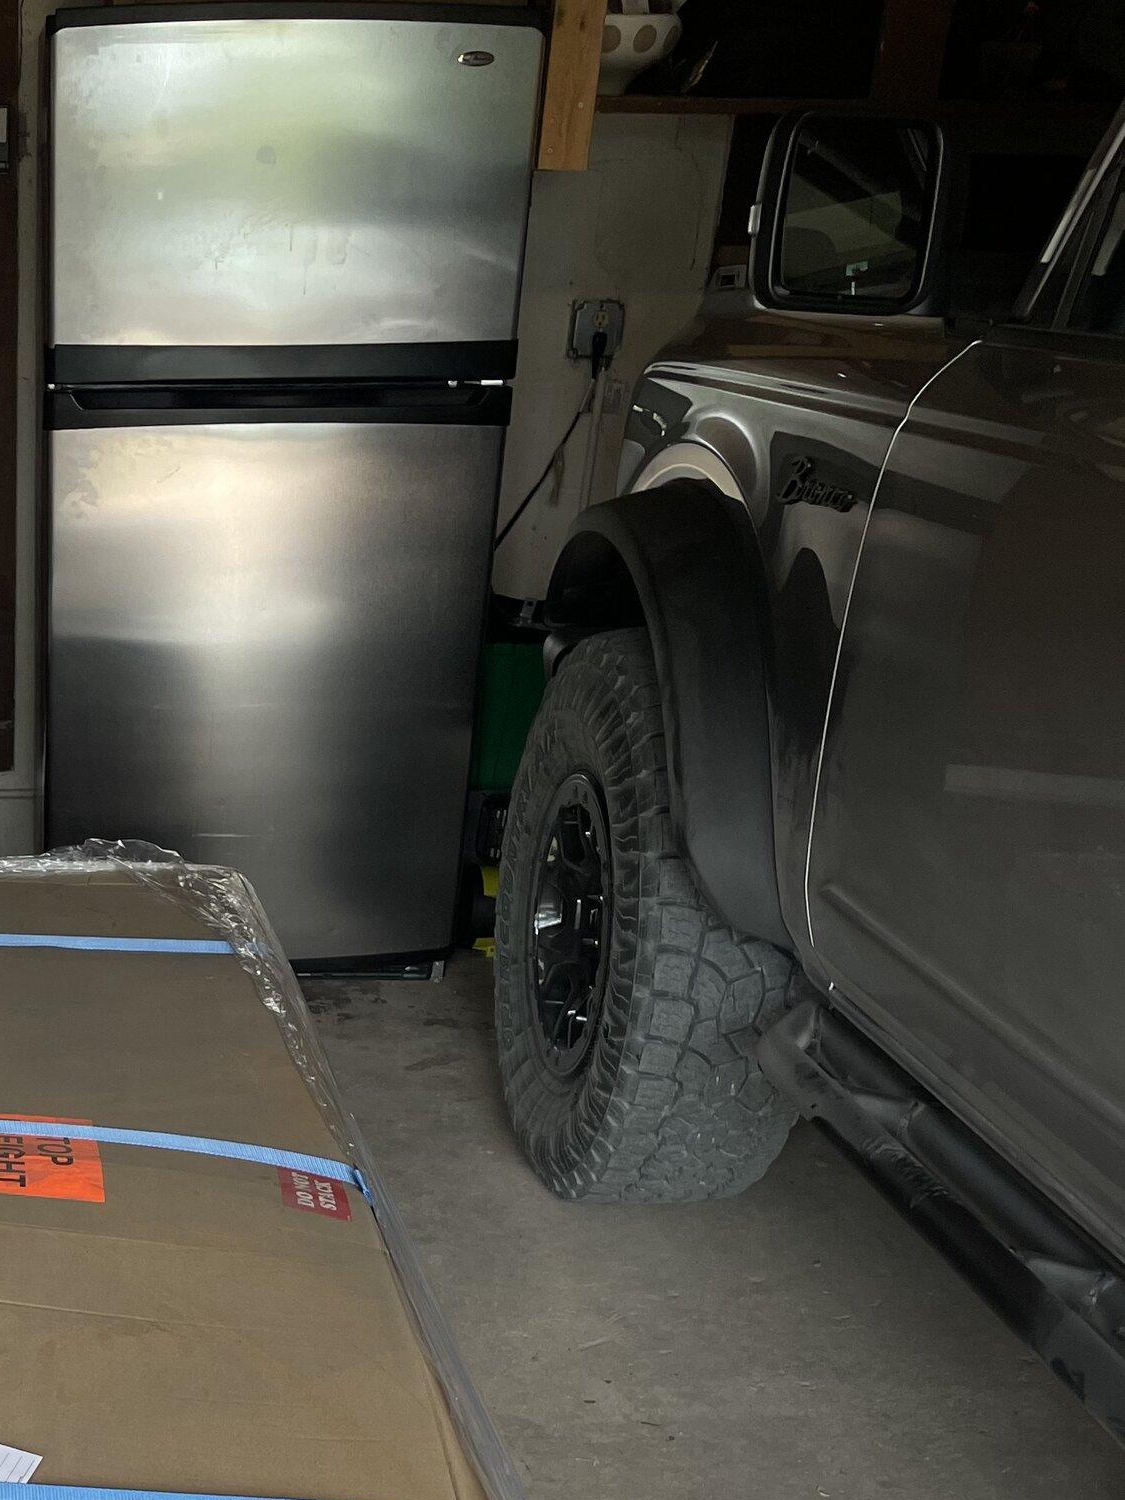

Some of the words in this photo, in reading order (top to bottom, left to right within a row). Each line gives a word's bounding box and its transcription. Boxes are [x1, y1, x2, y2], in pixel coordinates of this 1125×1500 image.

[291, 1171, 312, 1192] NOT
[296, 1191, 315, 1208] DO
[314, 1179, 337, 1211] STACK
